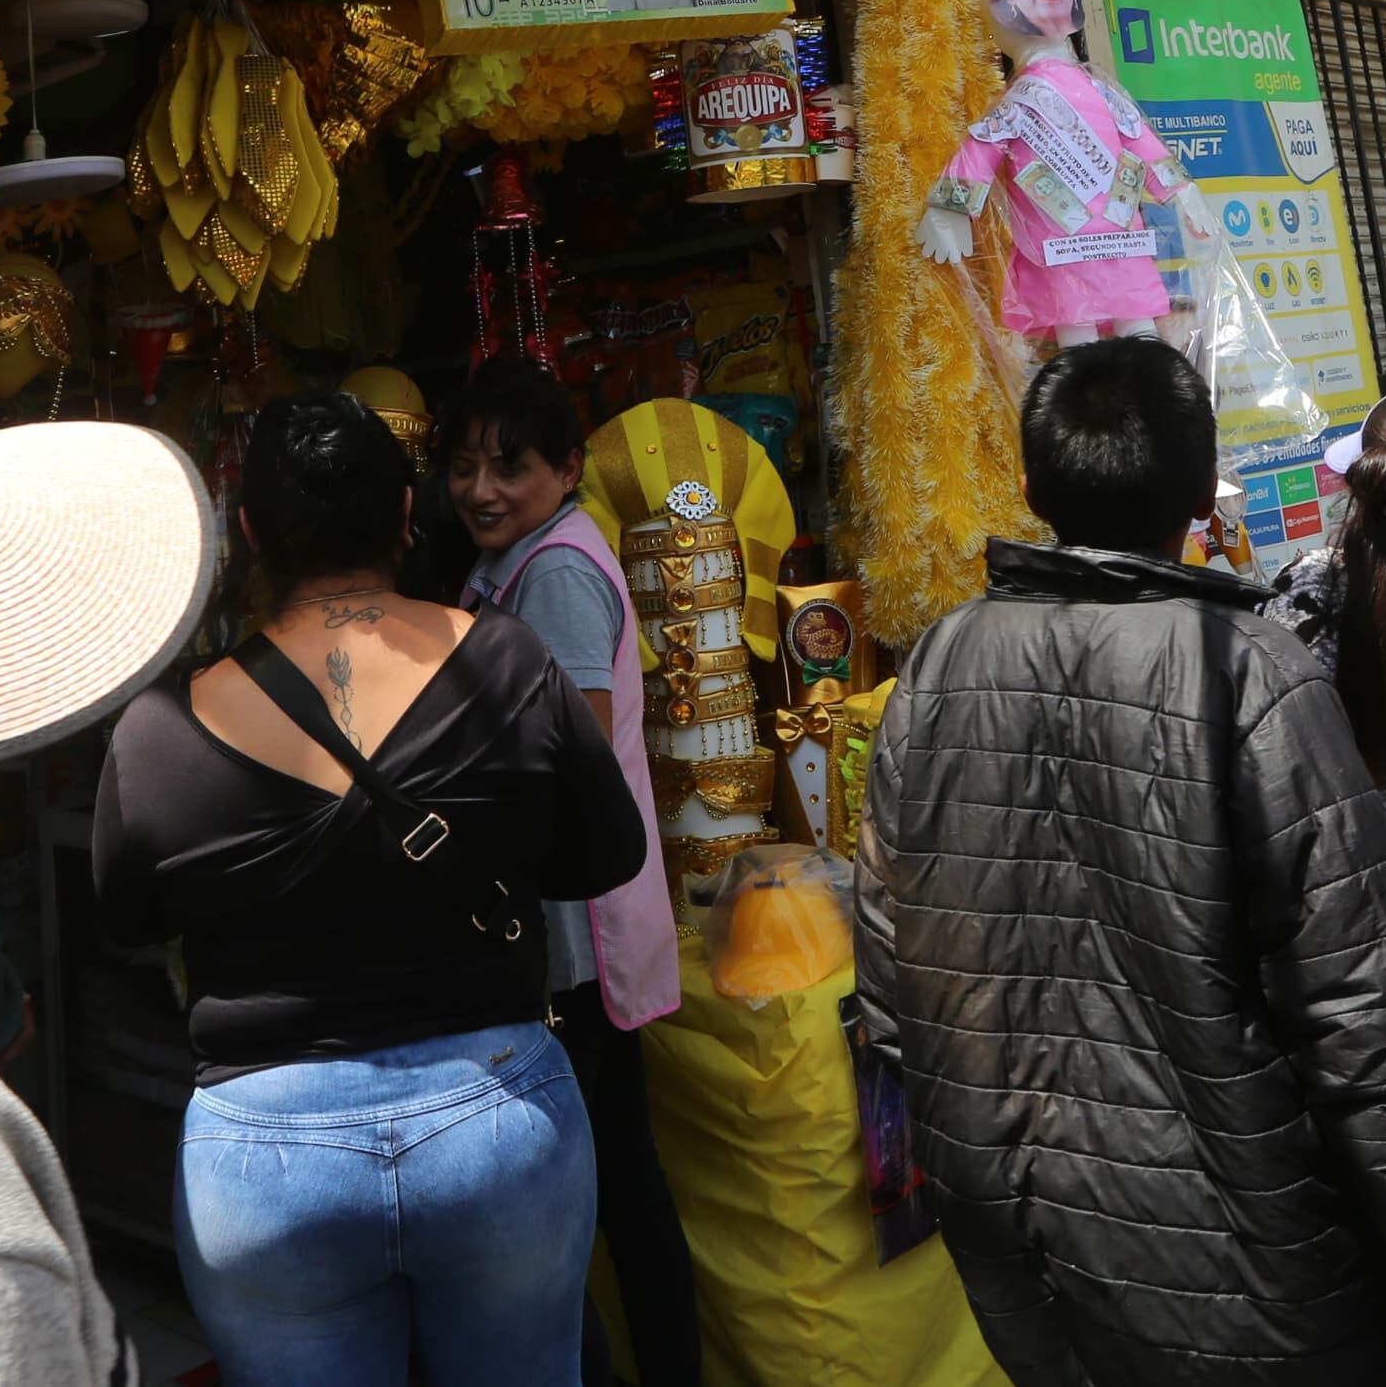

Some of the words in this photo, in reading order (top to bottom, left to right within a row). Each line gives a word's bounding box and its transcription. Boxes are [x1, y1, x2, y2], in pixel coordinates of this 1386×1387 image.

[1159, 18, 1296, 61] Interbank
[1253, 72, 1302, 95] agente
[698, 85, 791, 122] AREQUIPA
[1165, 115, 1226, 128] MULTIBANCO
[1285, 118, 1315, 135] PAGA
[1061, 147, 1081, 168] FRUTO
[1049, 239, 1067, 247] CON
